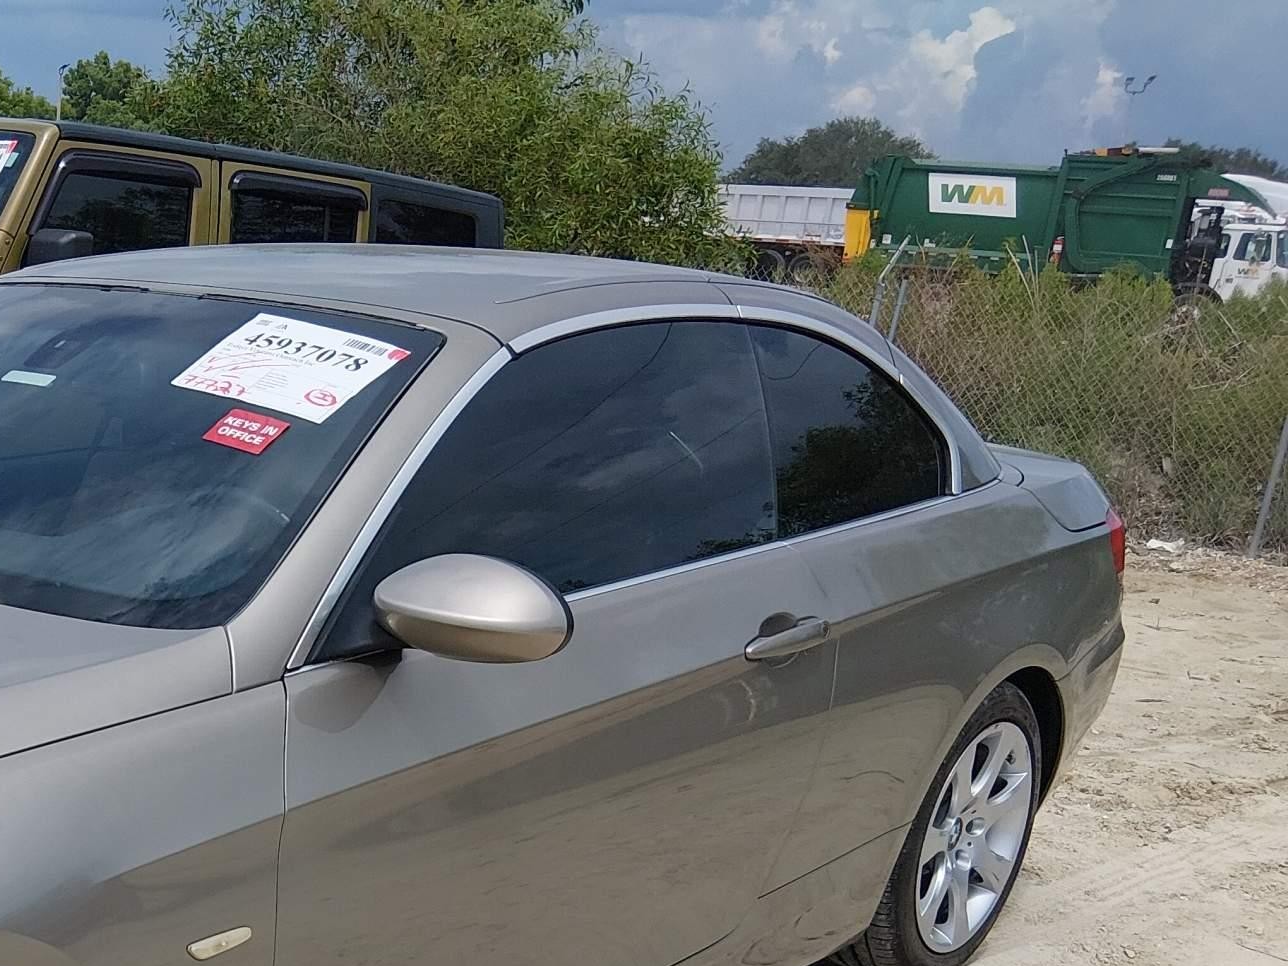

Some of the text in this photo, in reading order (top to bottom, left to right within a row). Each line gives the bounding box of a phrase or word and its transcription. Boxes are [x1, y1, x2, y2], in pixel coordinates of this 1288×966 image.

[941, 184, 1004, 207] WM
[245, 332, 369, 373] 45937078
[217, 426, 265, 445] OFFICE
[224, 416, 279, 436] KEYS IN
